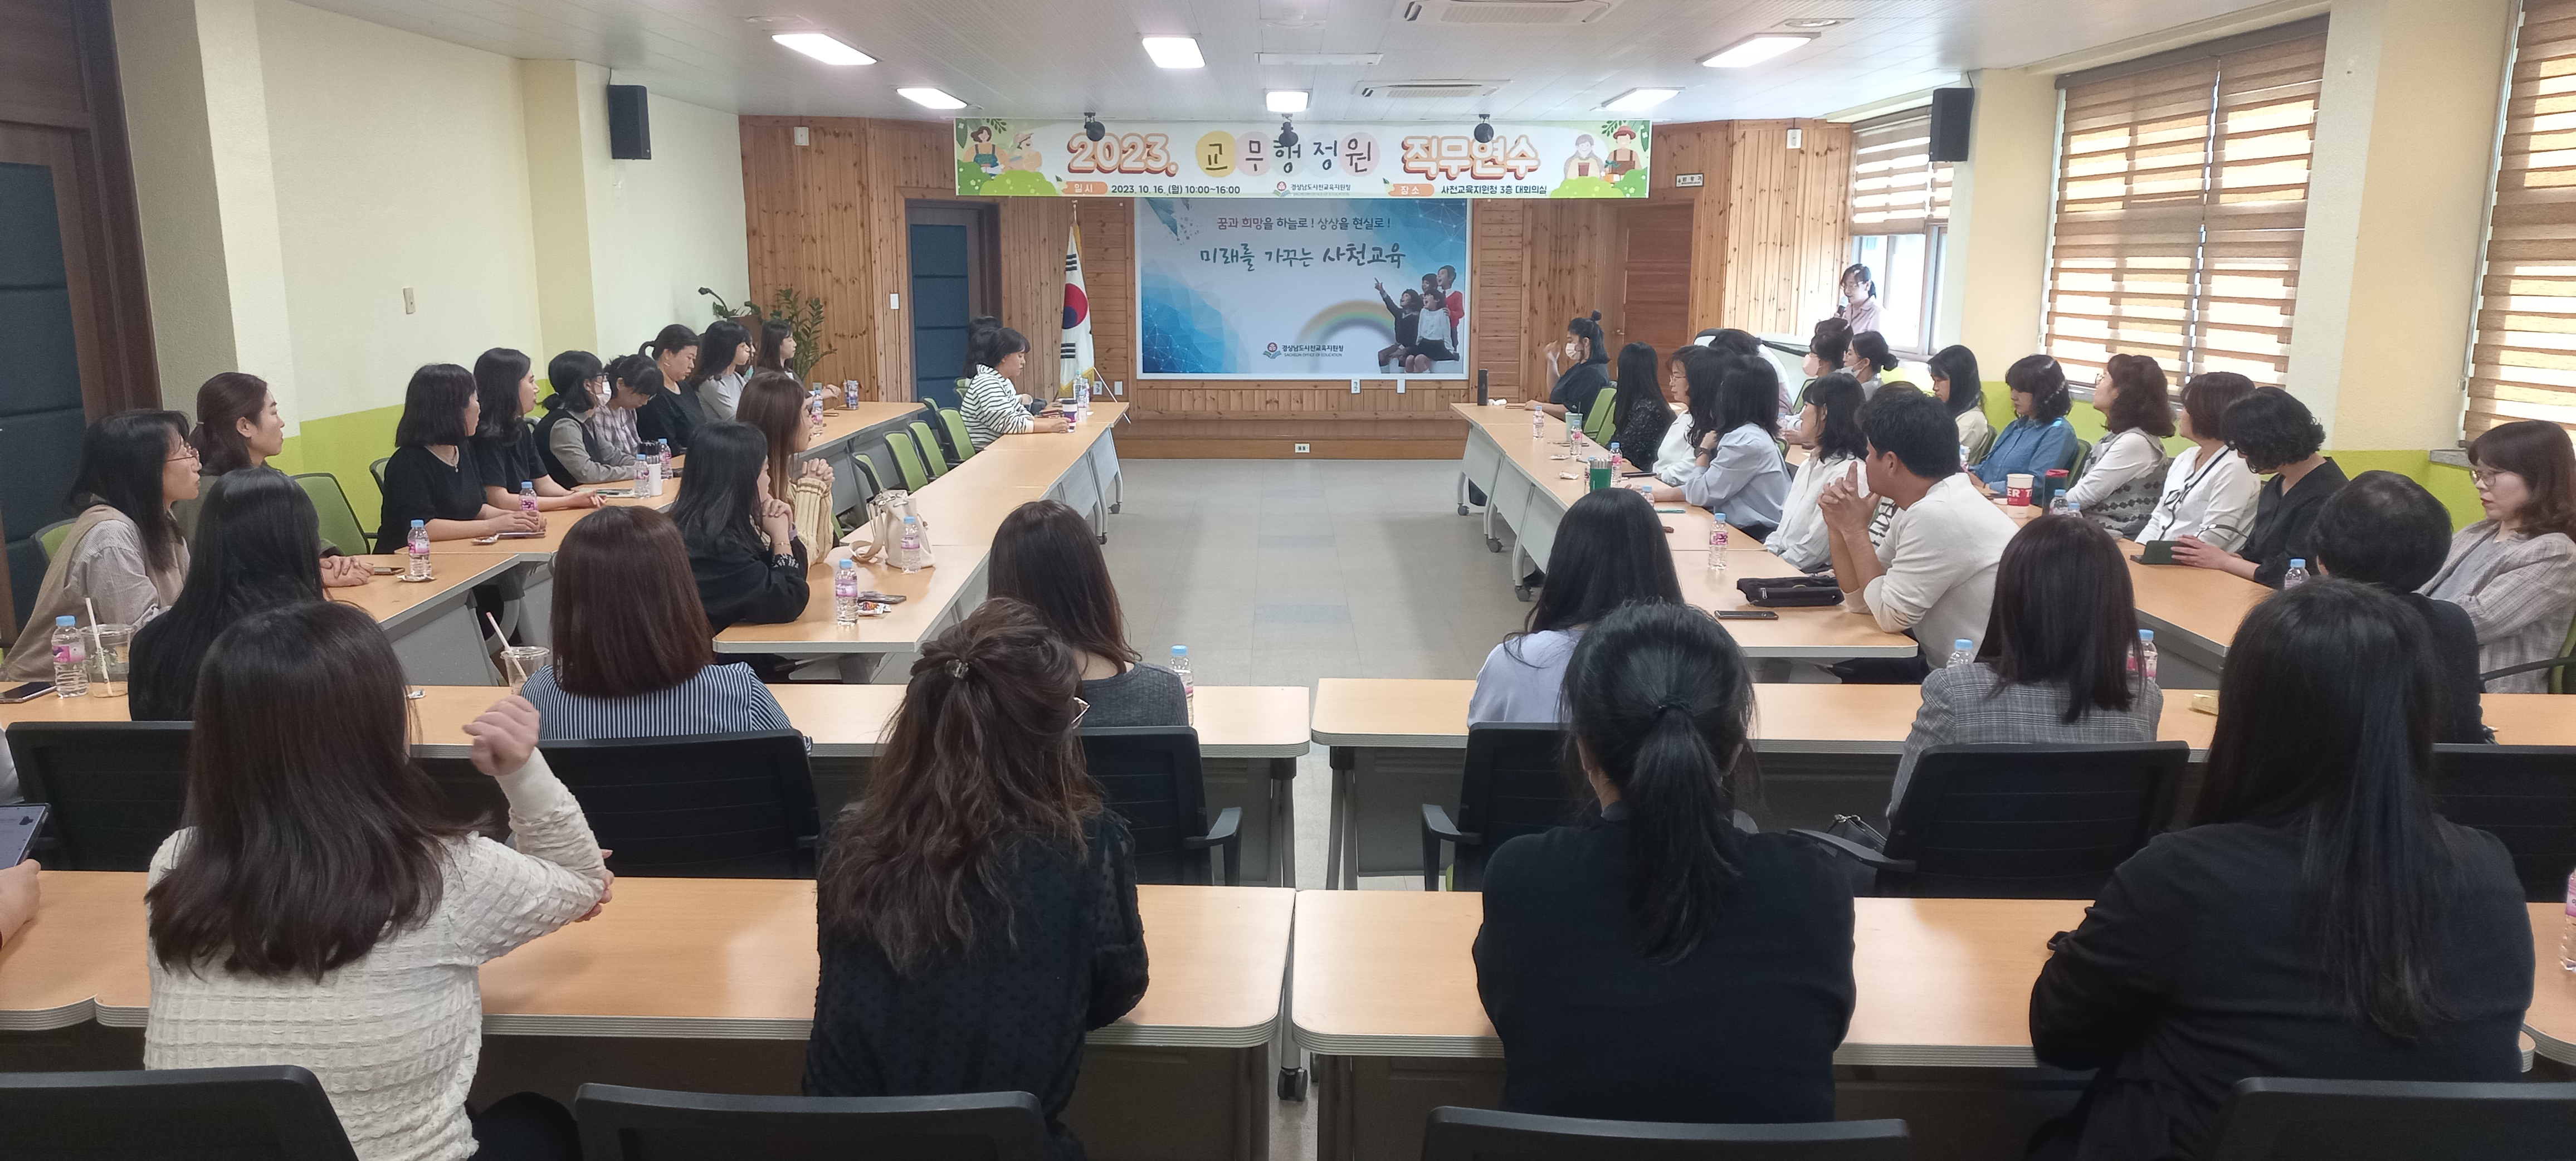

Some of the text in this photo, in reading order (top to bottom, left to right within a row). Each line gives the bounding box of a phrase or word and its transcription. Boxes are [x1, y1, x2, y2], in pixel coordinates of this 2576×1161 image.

[1067, 133, 1179, 177] 2023.
[1402, 134, 1541, 181] 직무연수
[1185, 186, 1240, 194] 10:00~16:00
[1441, 185, 1546, 194] 사천교육지원청 3층 대회의실
[1217, 217, 1238, 230] 꿈과
[1241, 217, 1274, 230] 희망을
[1318, 217, 1349, 230] 상상을
[1201, 242, 1406, 271] 미래를 가꾸는 사천교육
